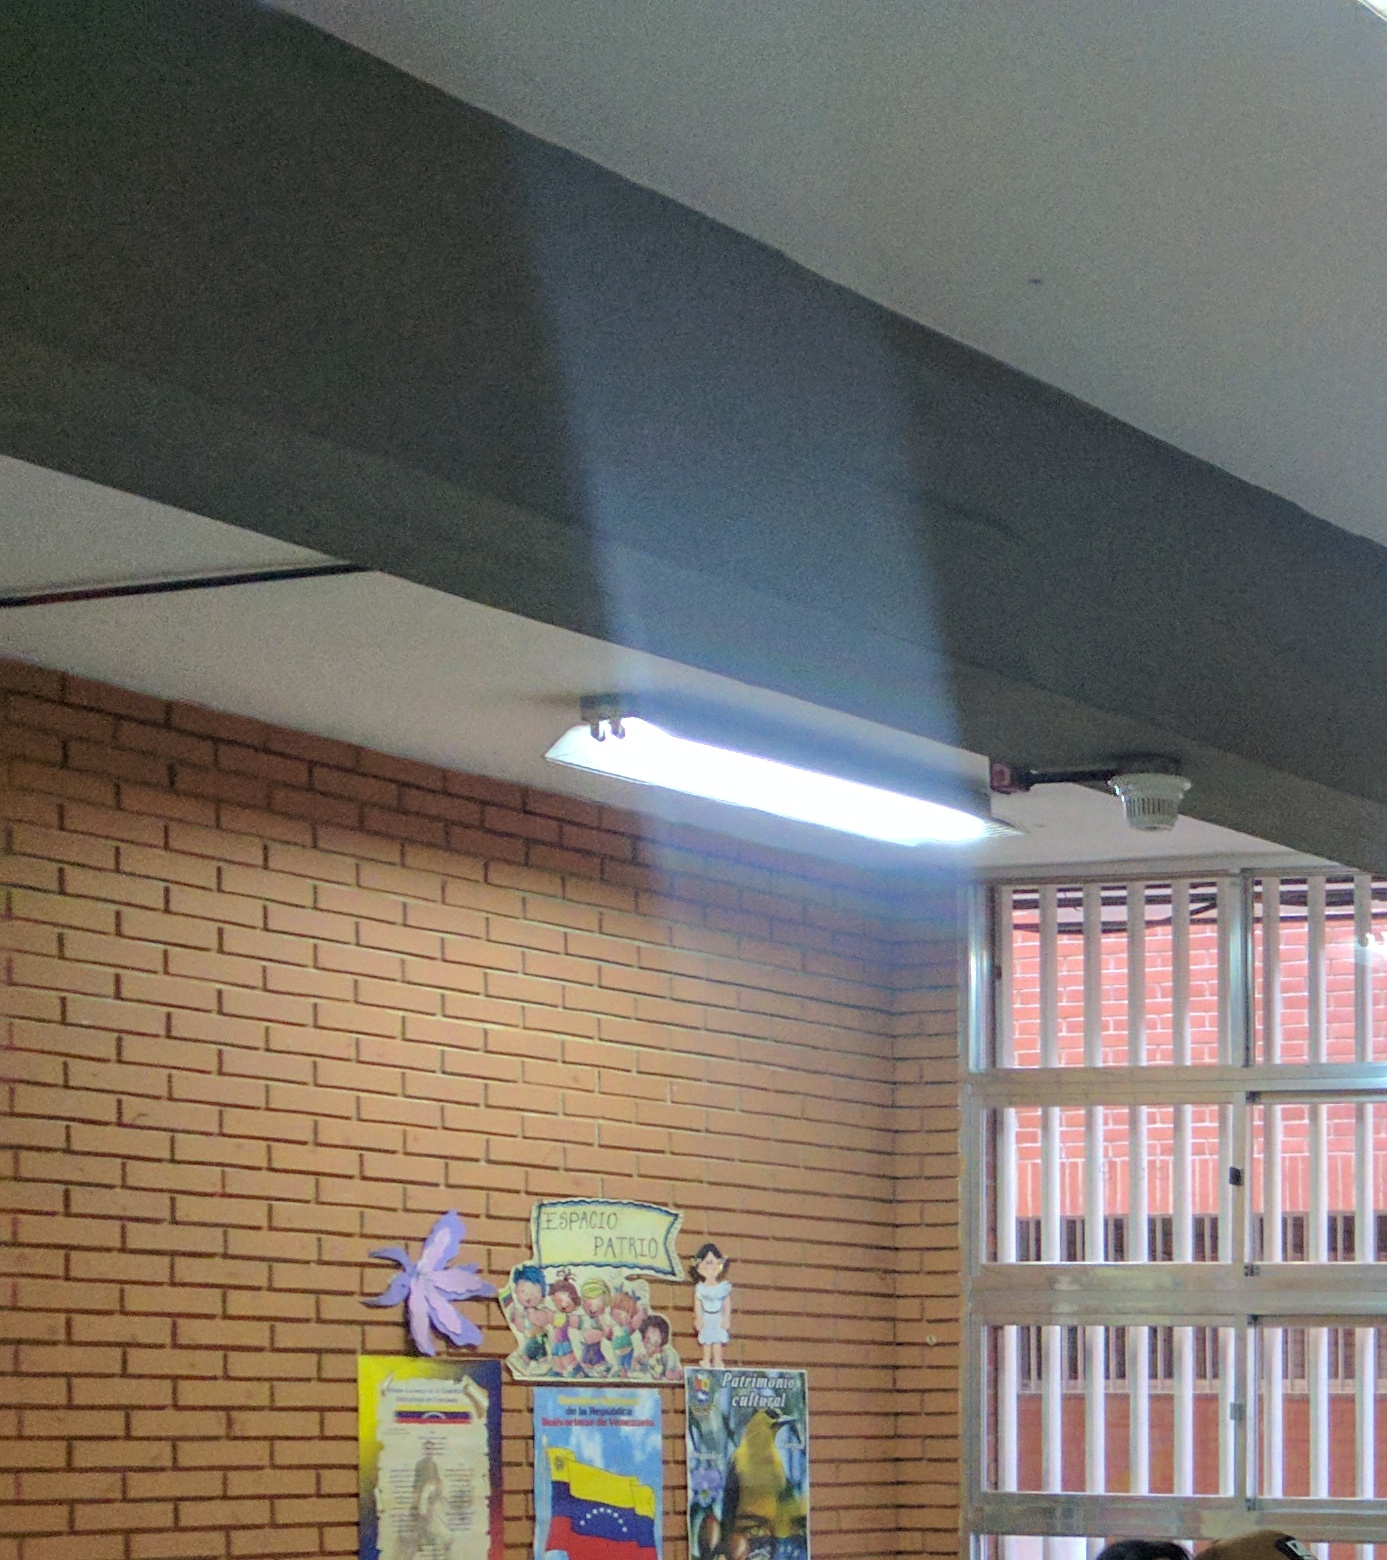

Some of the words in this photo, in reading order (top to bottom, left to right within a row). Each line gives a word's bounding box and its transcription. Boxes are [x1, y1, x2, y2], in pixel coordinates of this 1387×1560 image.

[542, 1210, 618, 1231] ESPACIO
[593, 1236, 658, 1259] PATRIO
[721, 1372, 795, 1389] Patrimonio
[731, 1392, 786, 1408] cultural
